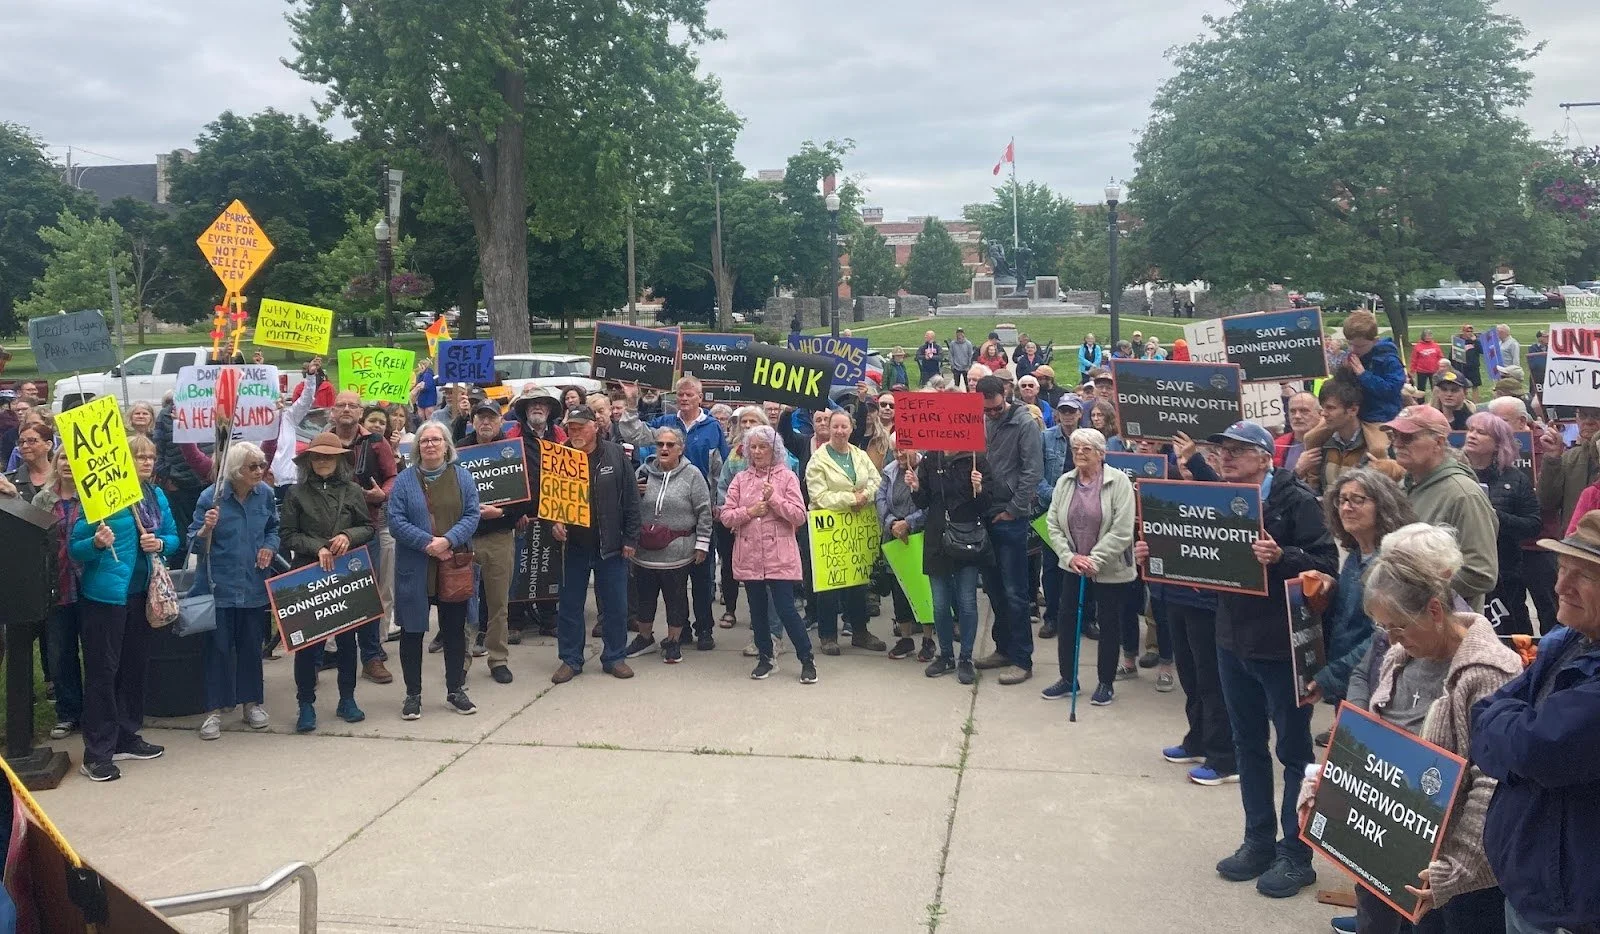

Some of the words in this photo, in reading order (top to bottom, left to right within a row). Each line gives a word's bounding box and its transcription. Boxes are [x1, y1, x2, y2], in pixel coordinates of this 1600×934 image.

[224, 210, 252, 225] PARKS
[214, 221, 232, 232] ARE
[236, 225, 254, 235] FOR
[208, 233, 258, 248] EVERYONE
[215, 247, 236, 257] NOT
[242, 250, 249, 259] A
[211, 256, 252, 270] SELECT
[222, 270, 244, 280] FEW
[264, 303, 290, 318] WHY
[260, 316, 291, 329] TOWN
[295, 321, 327, 335] WARD
[1256, 327, 1287, 338] SAVE
[266, 330, 322, 345] MATTER?
[623, 338, 649, 350] SAVE
[1194, 326, 1219, 346] LE
[448, 344, 486, 361] GET
[704, 344, 727, 352] SAVE
[1227, 337, 1321, 354] BONNERWORTH
[595, 346, 675, 366] BONNERWORTH
[1260, 353, 1291, 365] PARK
[446, 357, 492, 380] REAL!
[619, 360, 647, 372] PARK
[703, 363, 727, 372] PARK
[834, 363, 862, 382] O?
[360, 371, 396, 379] DON'T
[753, 357, 823, 398] HONK
[1549, 365, 1586, 387] DON'T
[187, 383, 270, 398] BONORTH
[724, 385, 741, 393] PAR
[1156, 380, 1195, 392] SAVE
[898, 397, 936, 410] JEFF
[1118, 393, 1240, 411] BONNERWORTH
[1243, 399, 1281, 419] BLES
[177, 408, 189, 430] A
[193, 406, 217, 429] HEA
[233, 405, 275, 428] SLAND
[901, 411, 943, 423] START
[1159, 411, 1200, 424] PARK
[73, 409, 119, 461] ACT!
[898, 426, 913, 439] ALL
[918, 429, 970, 440] CITIZENS!
[542, 440, 583, 461] DON
[460, 457, 491, 470] SAVE
[471, 463, 524, 480] RWORTH
[542, 453, 588, 481] ERASE
[81, 452, 128, 499] PLAN!
[476, 481, 495, 492] RK
[541, 476, 589, 505] GREEN
[540, 497, 588, 526] SPACE
[1179, 504, 1217, 520] SAVE
[815, 514, 835, 529] NO
[837, 512, 853, 526] TO
[1143, 521, 1260, 543] BONNERWORTH
[520, 548, 529, 574] SAVE
[529, 521, 541, 599] BONNERWORTH
[541, 546, 551, 573] PARK
[1180, 544, 1221, 561] PARK
[826, 555, 846, 569] DOES
[851, 554, 868, 565] OUR
[307, 573, 340, 593] SAVE
[828, 568, 848, 584] NOT
[853, 565, 874, 580] MAT
[277, 575, 375, 620] BONNERWORTH
[314, 600, 349, 621] PARK
[1364, 753, 1404, 789] SAVE
[1323, 760, 1440, 844] BONNERWORTH
[1346, 808, 1388, 848] PARK
